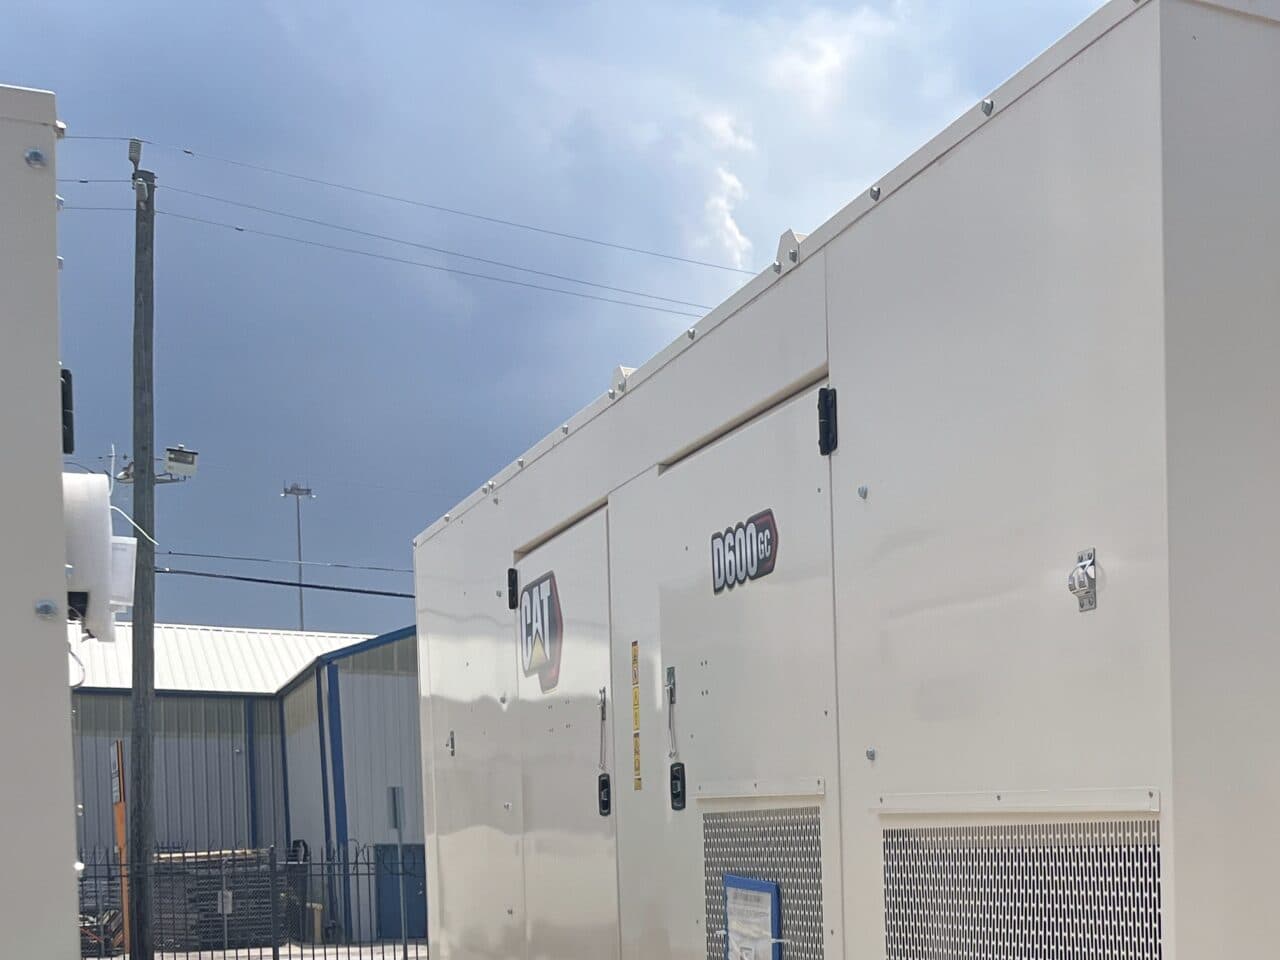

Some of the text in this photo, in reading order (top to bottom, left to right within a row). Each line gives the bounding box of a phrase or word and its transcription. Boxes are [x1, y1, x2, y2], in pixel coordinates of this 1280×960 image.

[712, 522, 771, 590] D600 GC
[520, 579, 551, 672] CAT
